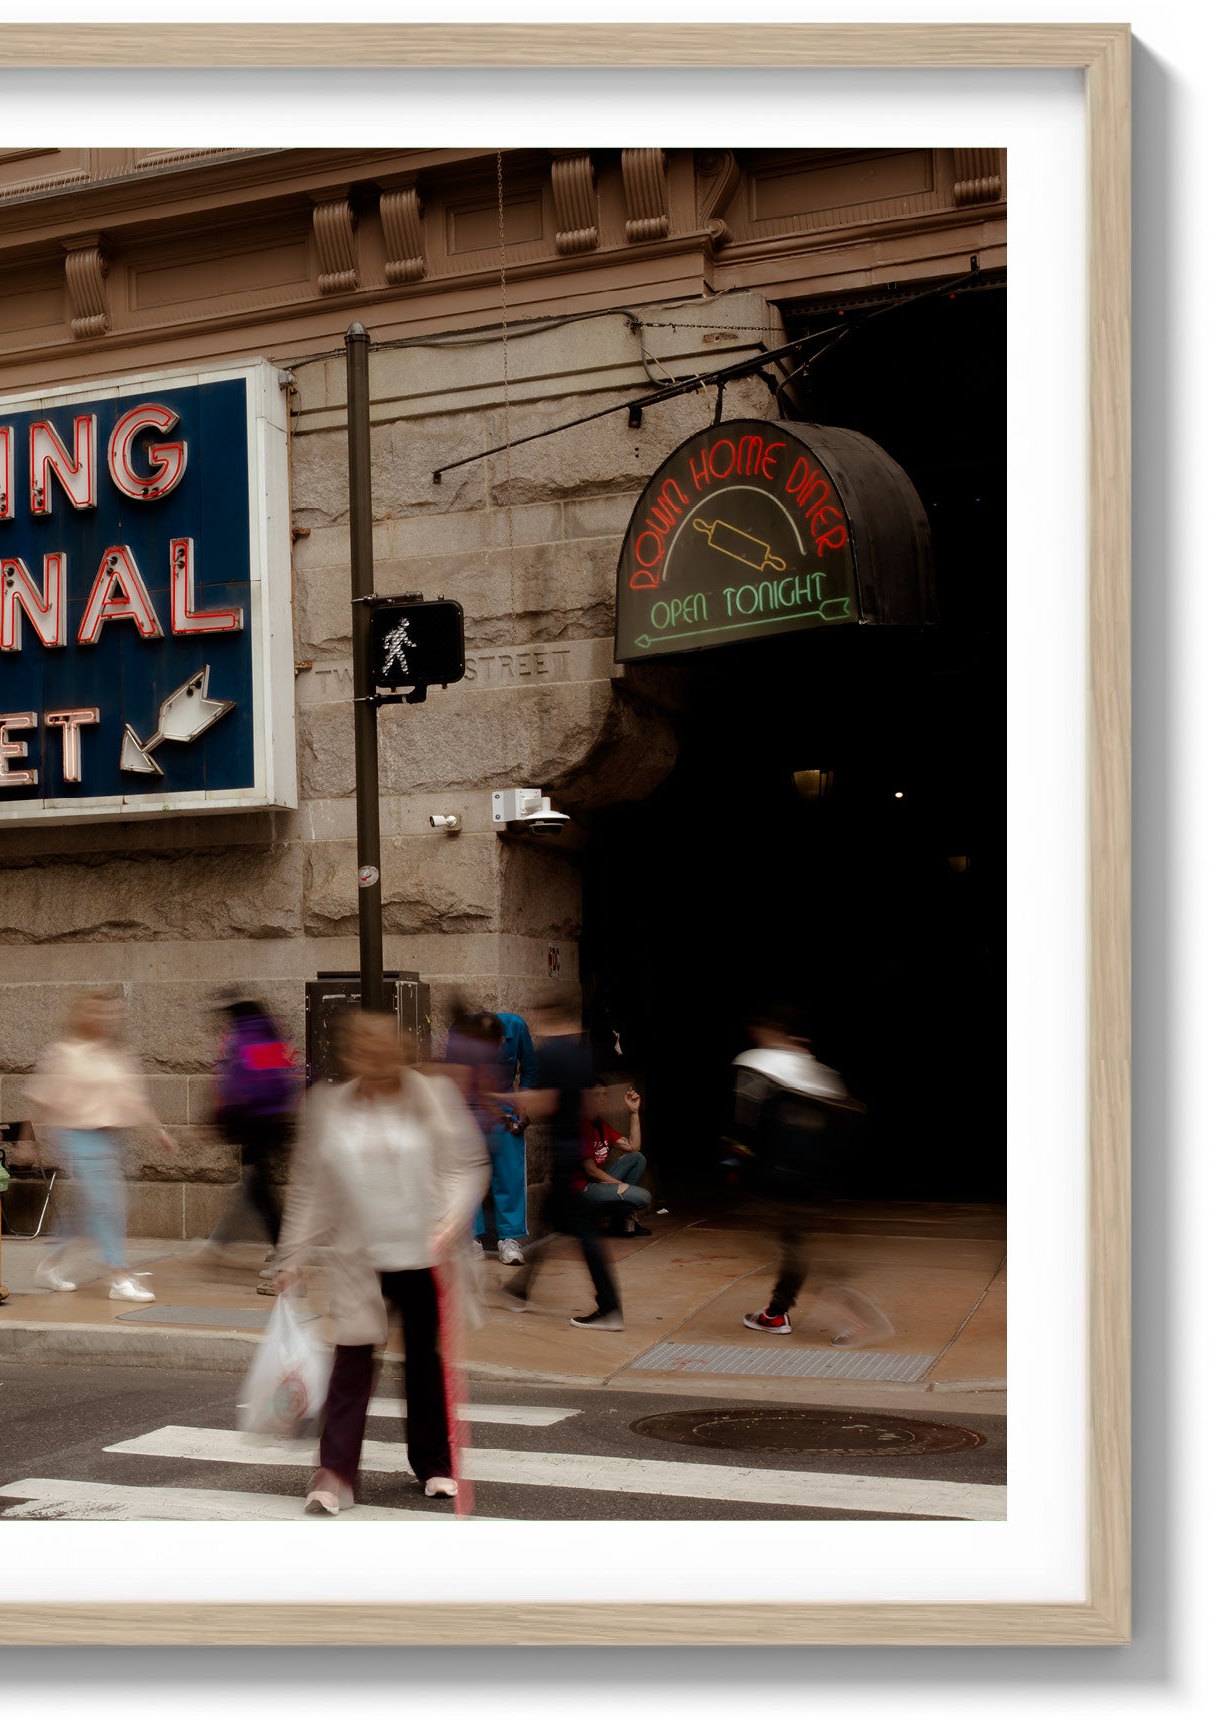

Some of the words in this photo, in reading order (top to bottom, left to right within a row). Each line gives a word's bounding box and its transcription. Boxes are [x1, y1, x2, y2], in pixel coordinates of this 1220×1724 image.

[629, 478, 691, 590] DOWN
[689, 435, 787, 491] HOME
[785, 456, 847, 558] DINER
[651, 592, 708, 630] OPEN
[723, 572, 827, 617] TONIGHT
[464, 650, 571, 681] STREET
